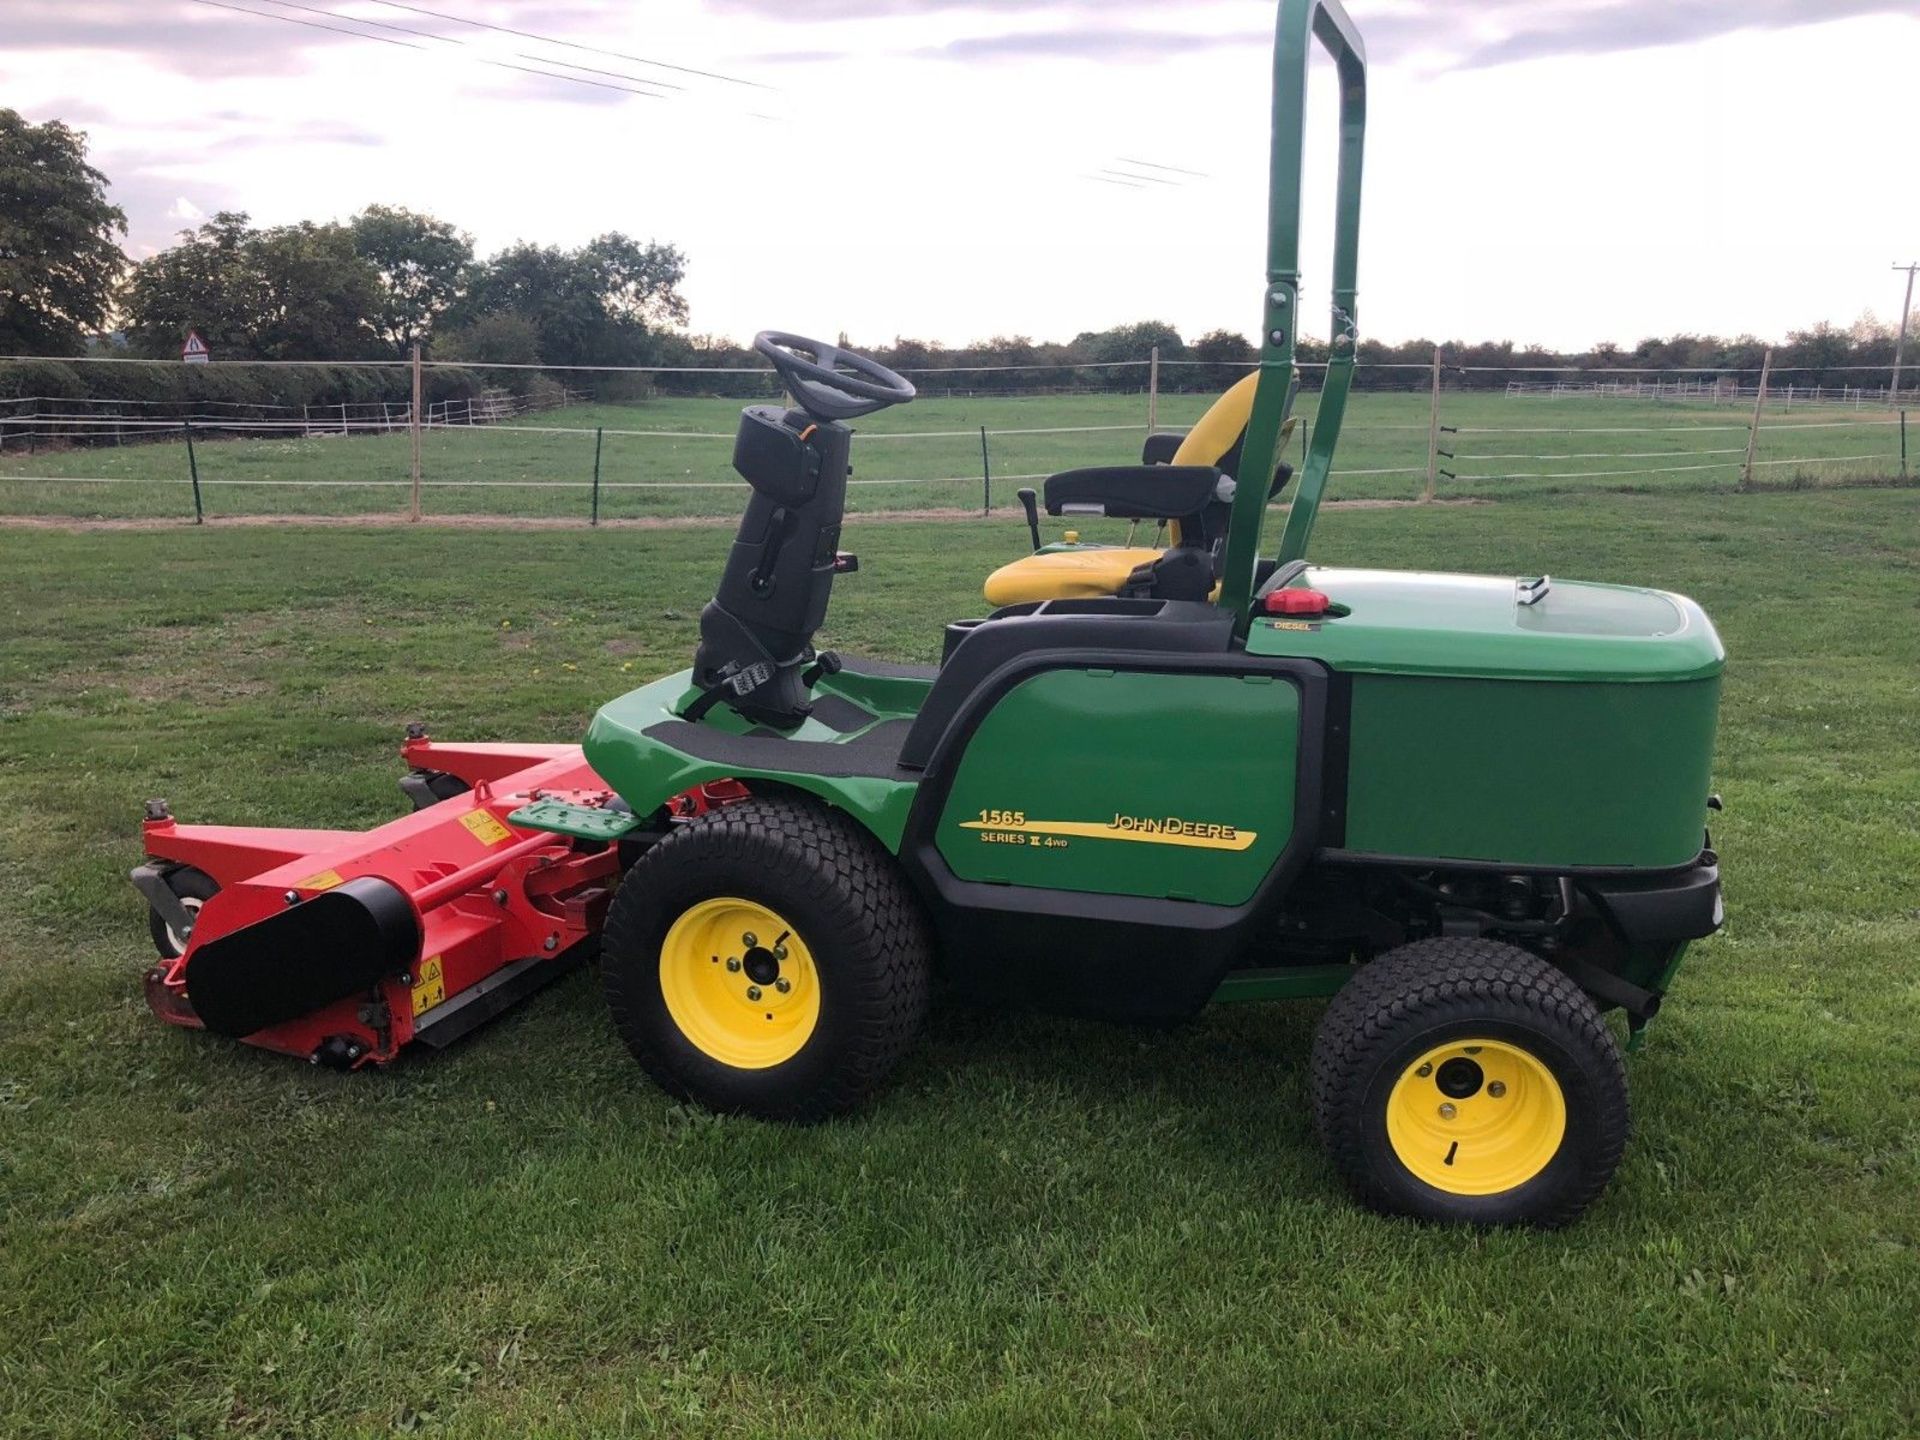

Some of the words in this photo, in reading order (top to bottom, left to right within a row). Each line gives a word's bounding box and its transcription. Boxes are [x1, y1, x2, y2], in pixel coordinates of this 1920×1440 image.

[1274, 622, 1311, 631] DIESEL
[979, 809, 1025, 826] 1565
[1107, 813, 1162, 833] JOHN
[1165, 817, 1237, 840] DEERE
[981, 832, 1026, 844] SERIES
[1044, 837, 1068, 847] 4WD
